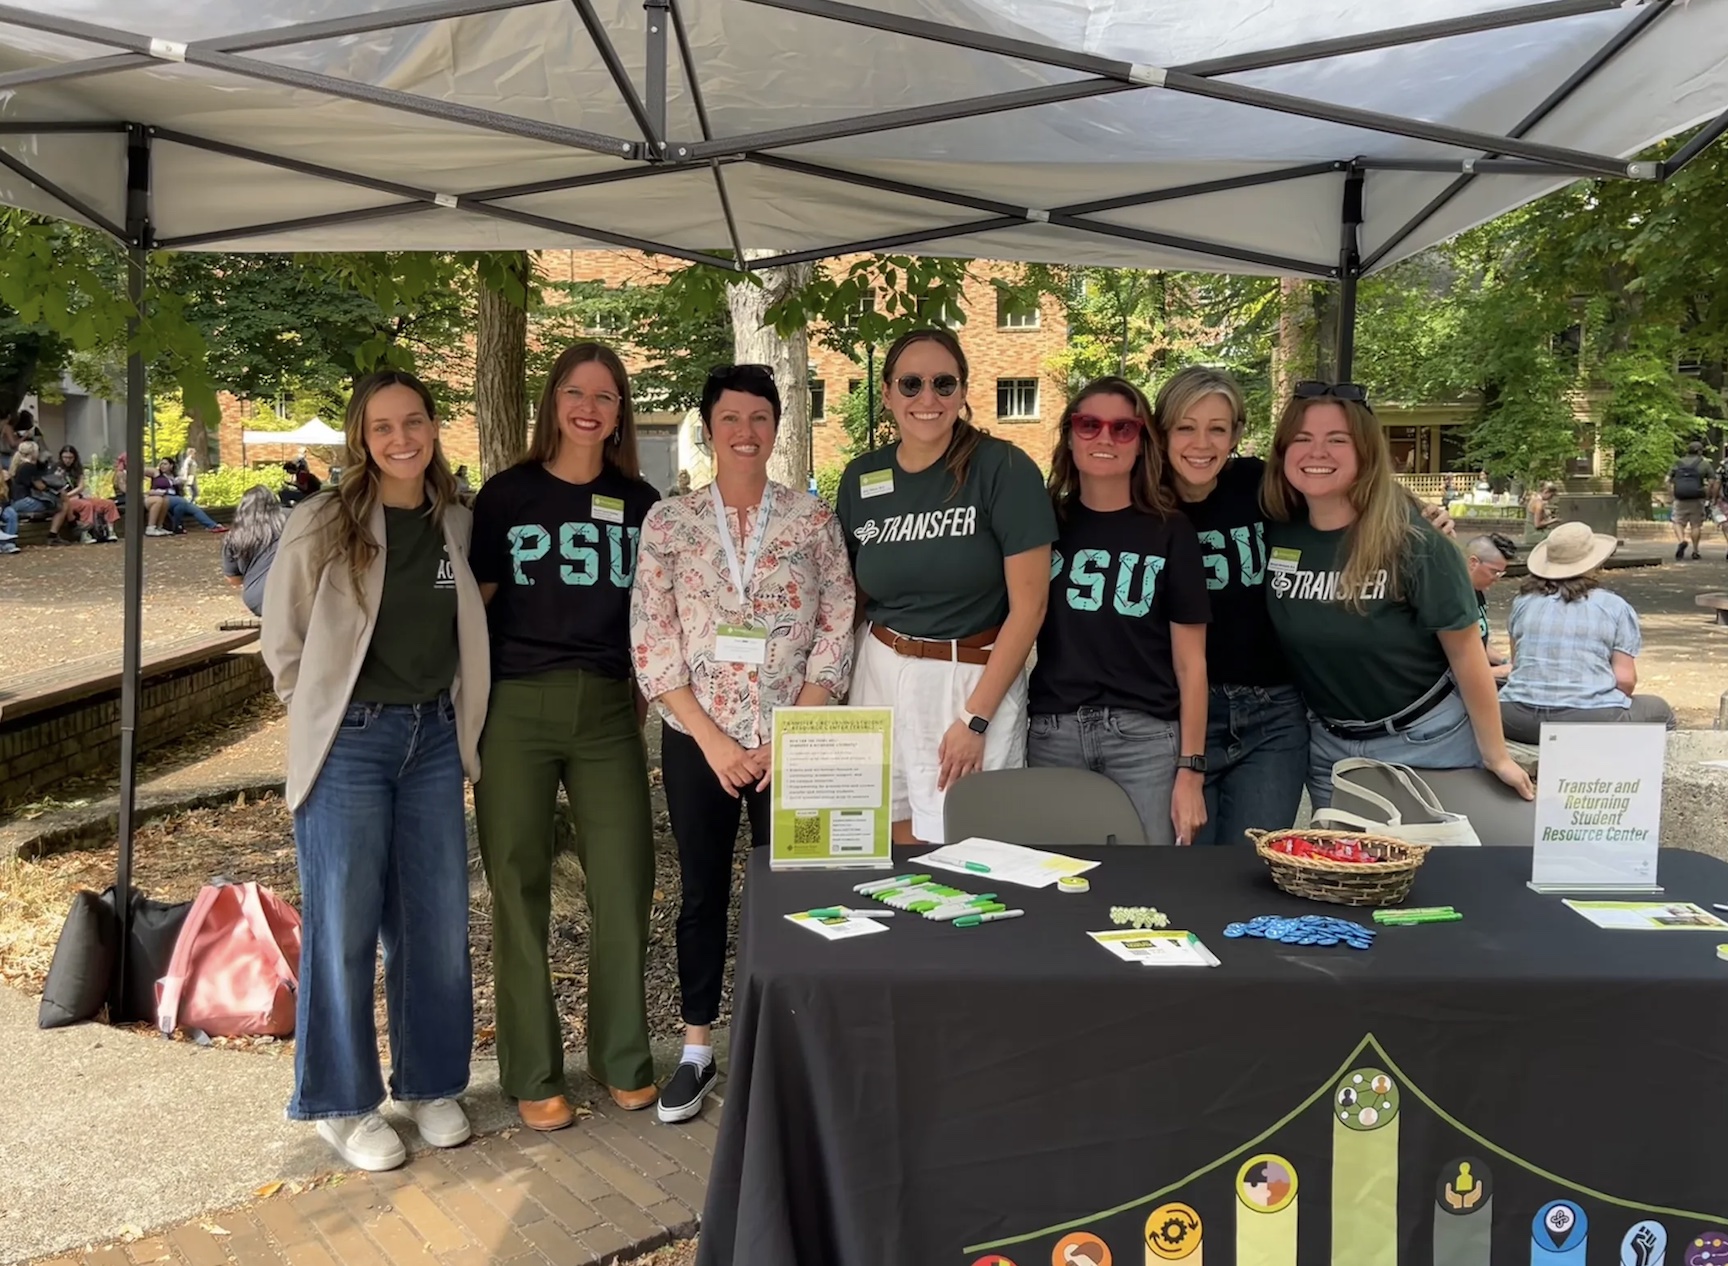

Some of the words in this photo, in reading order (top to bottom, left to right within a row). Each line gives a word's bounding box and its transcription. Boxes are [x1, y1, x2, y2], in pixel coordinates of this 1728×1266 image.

[876, 505, 977, 545] TRANSFER
[507, 522, 640, 588] PSU
[1050, 549, 1166, 618] SU
[1558, 778, 1613, 793] Transfer
[1614, 779, 1641, 793] and
[1564, 794, 1630, 812] Returning
[1571, 811, 1623, 825] Student
[1542, 827, 1603, 841] Resource
[1606, 827, 1648, 841] Center
